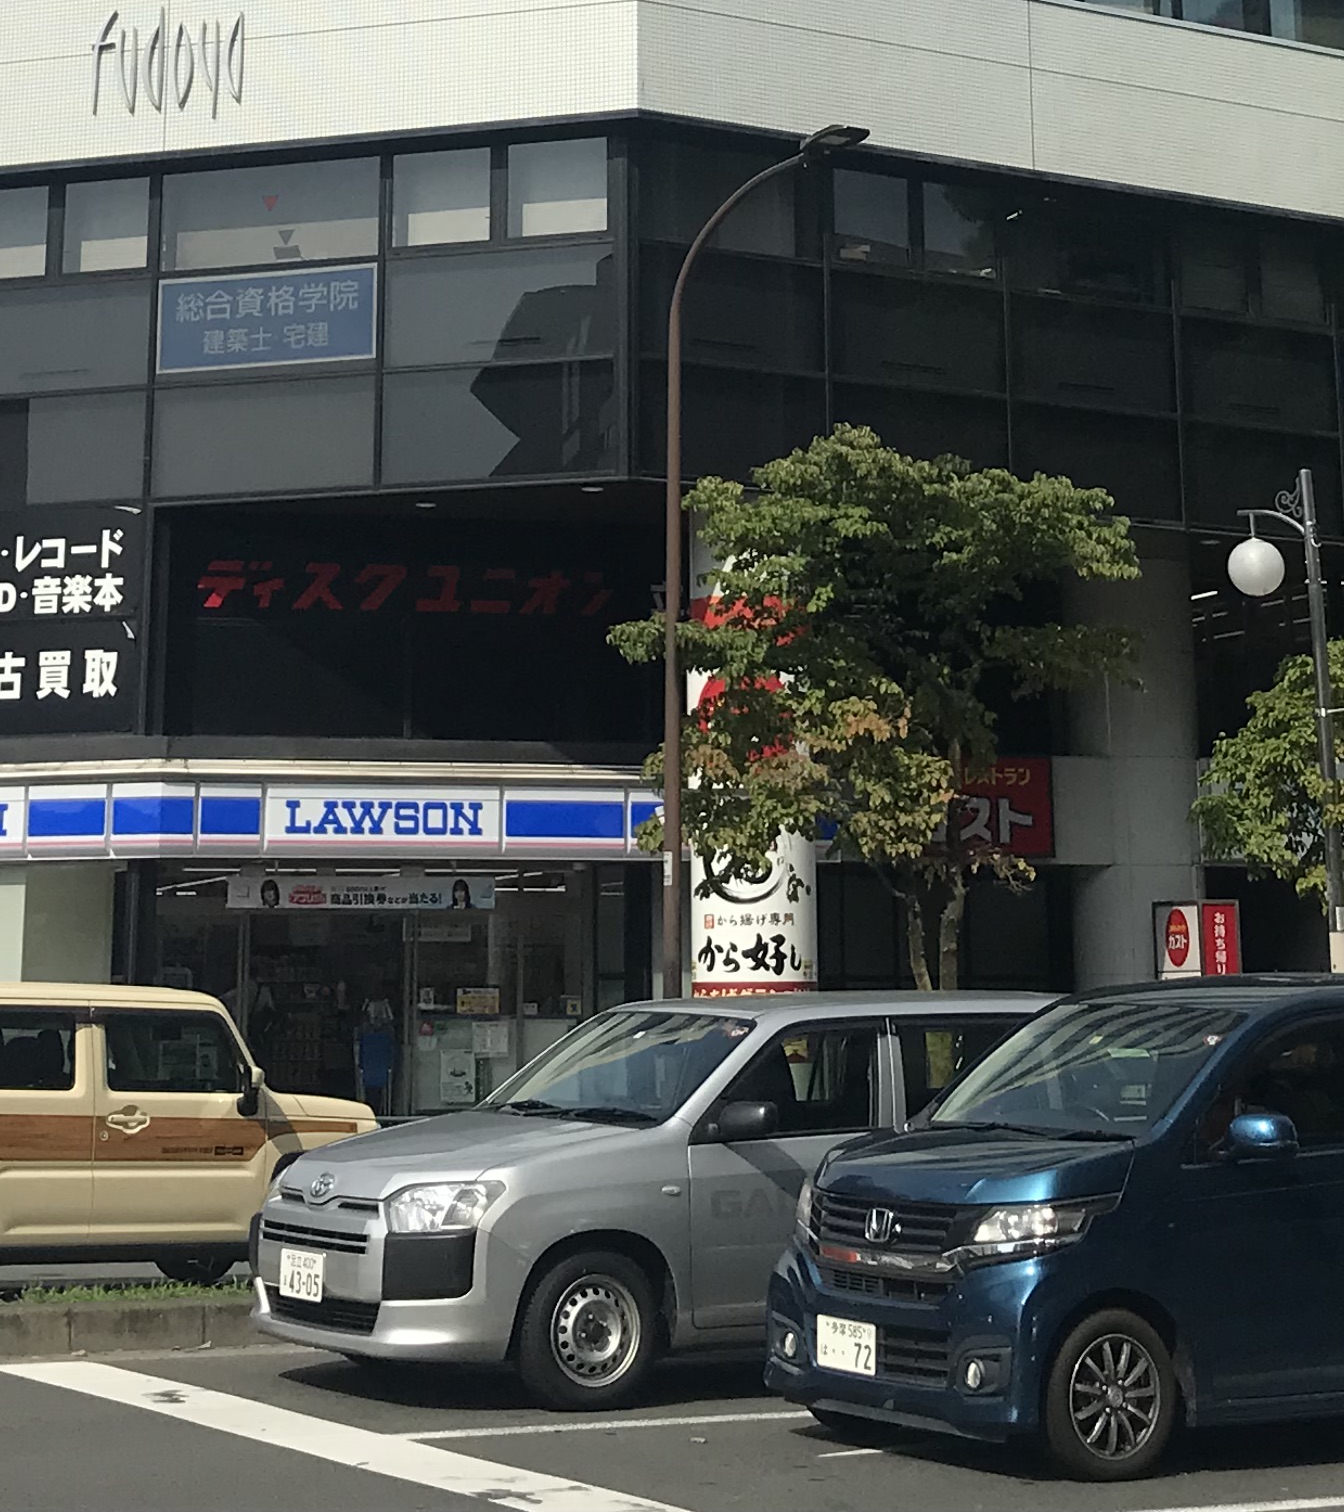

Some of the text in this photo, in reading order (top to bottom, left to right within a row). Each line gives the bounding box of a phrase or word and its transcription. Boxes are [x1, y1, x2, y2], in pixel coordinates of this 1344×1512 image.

[176, 280, 360, 323] 総合資格学院
[285, 799, 483, 836] LAWSON
[717, 913, 795, 927] から揚げ専門
[698, 933, 803, 976] から好し
